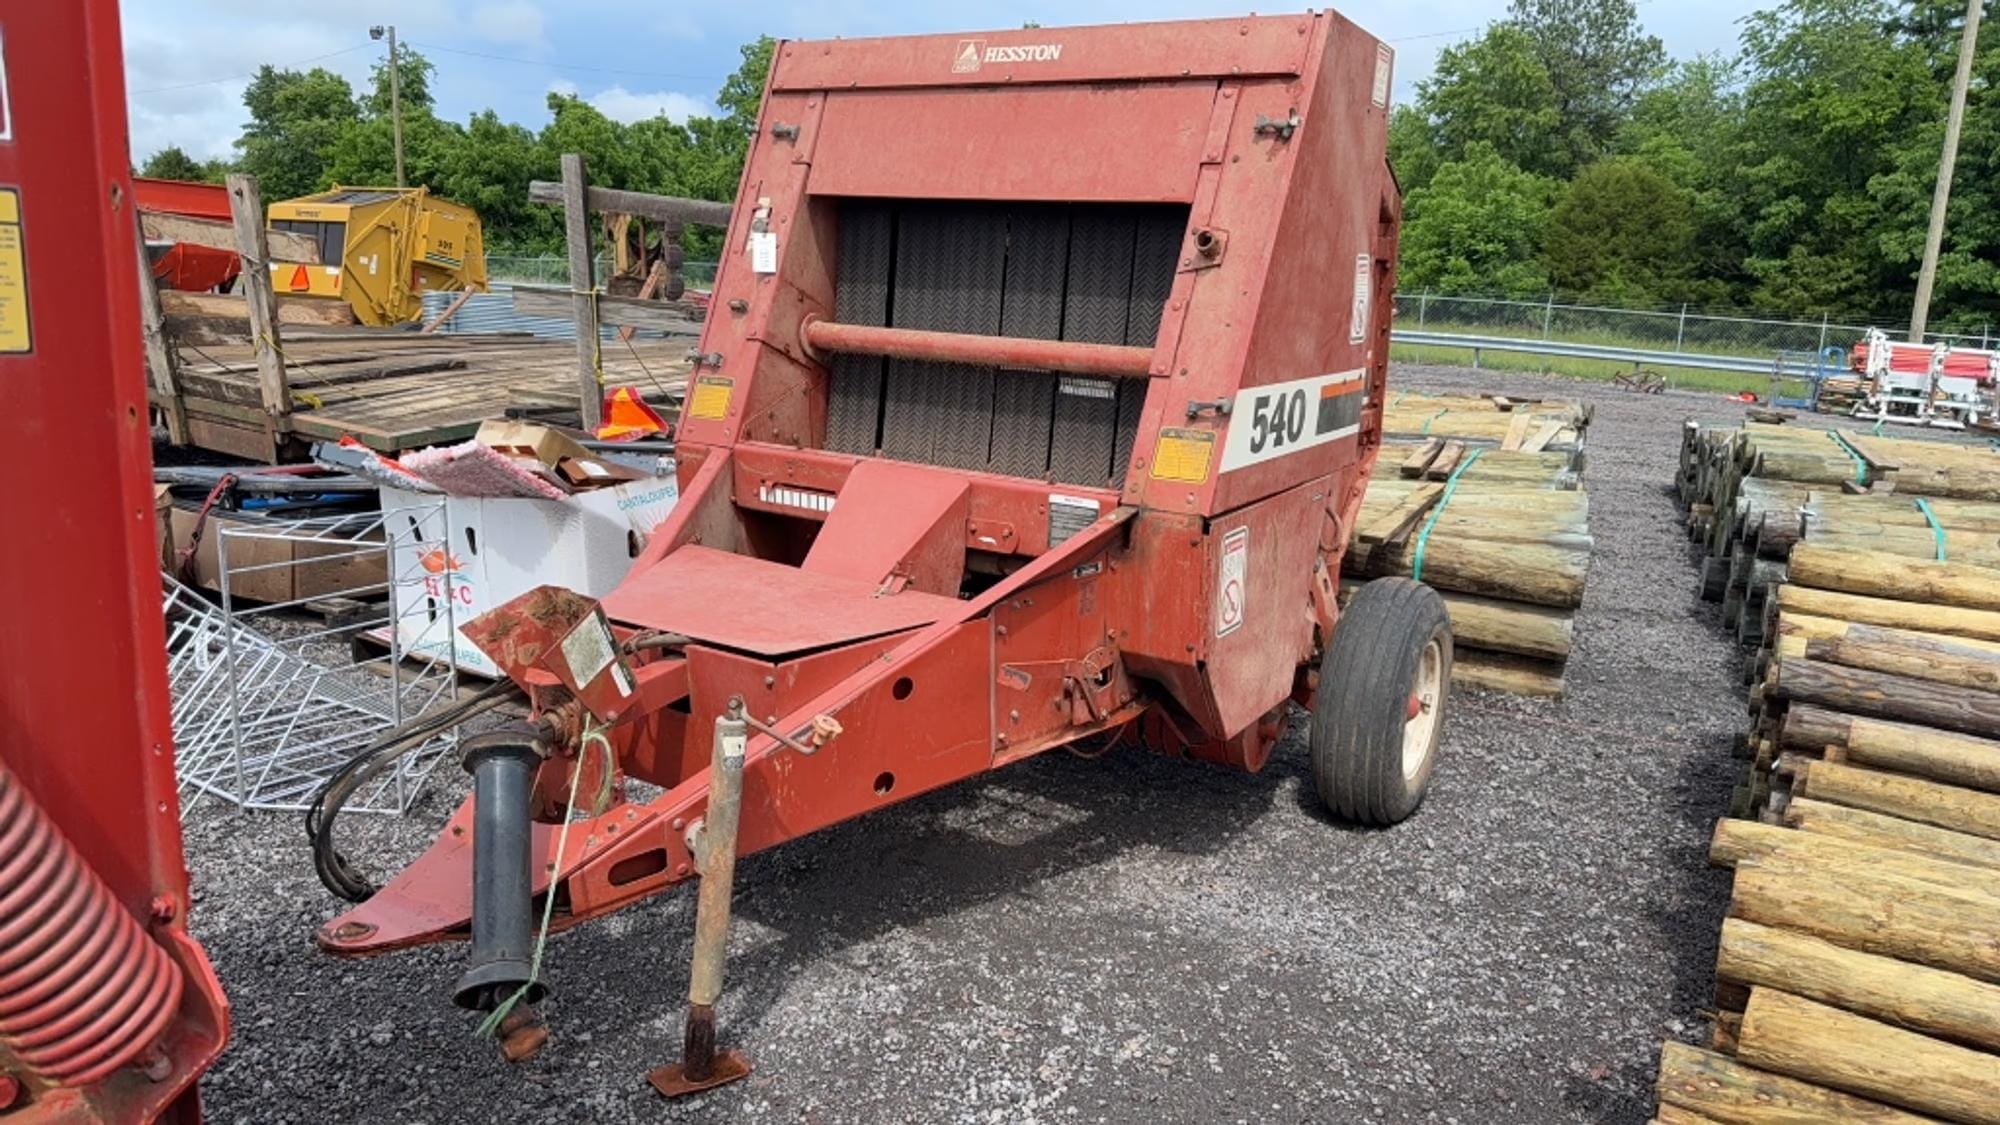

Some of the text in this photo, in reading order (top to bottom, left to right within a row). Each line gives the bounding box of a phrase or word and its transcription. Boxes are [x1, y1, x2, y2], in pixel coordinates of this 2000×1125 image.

[983, 44, 1063, 63] HESSTON
[1250, 388, 1306, 454] 540
[460, 585, 472, 605] C
